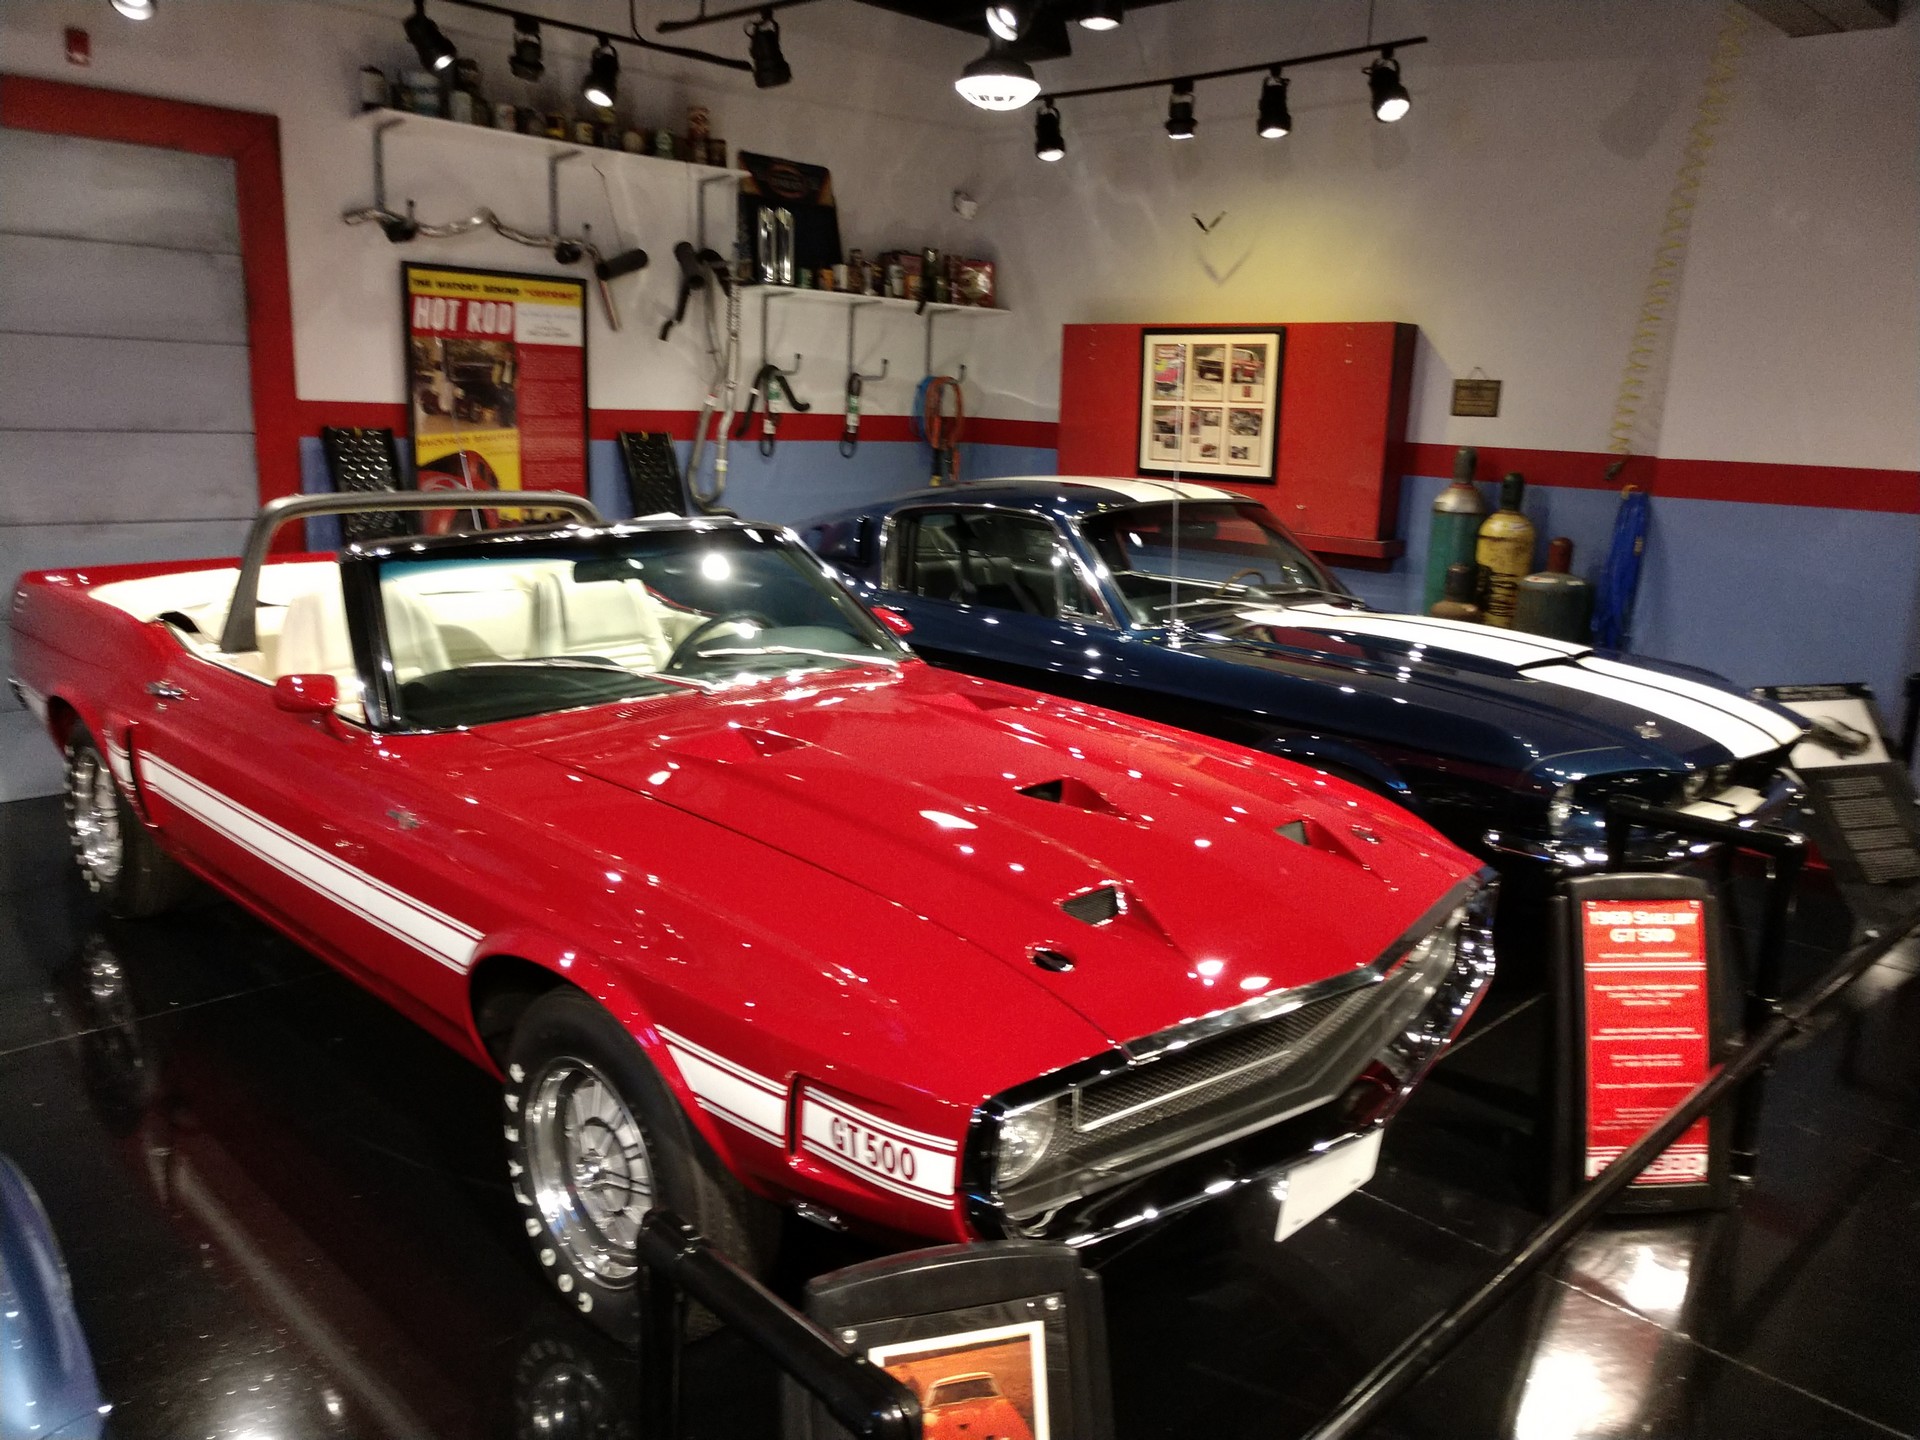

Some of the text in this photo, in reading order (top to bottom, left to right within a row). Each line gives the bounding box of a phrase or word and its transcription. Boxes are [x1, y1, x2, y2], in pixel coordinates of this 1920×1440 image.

[413, 296, 512, 335] HOT ROD
[831, 1117, 915, 1181] GT 500
